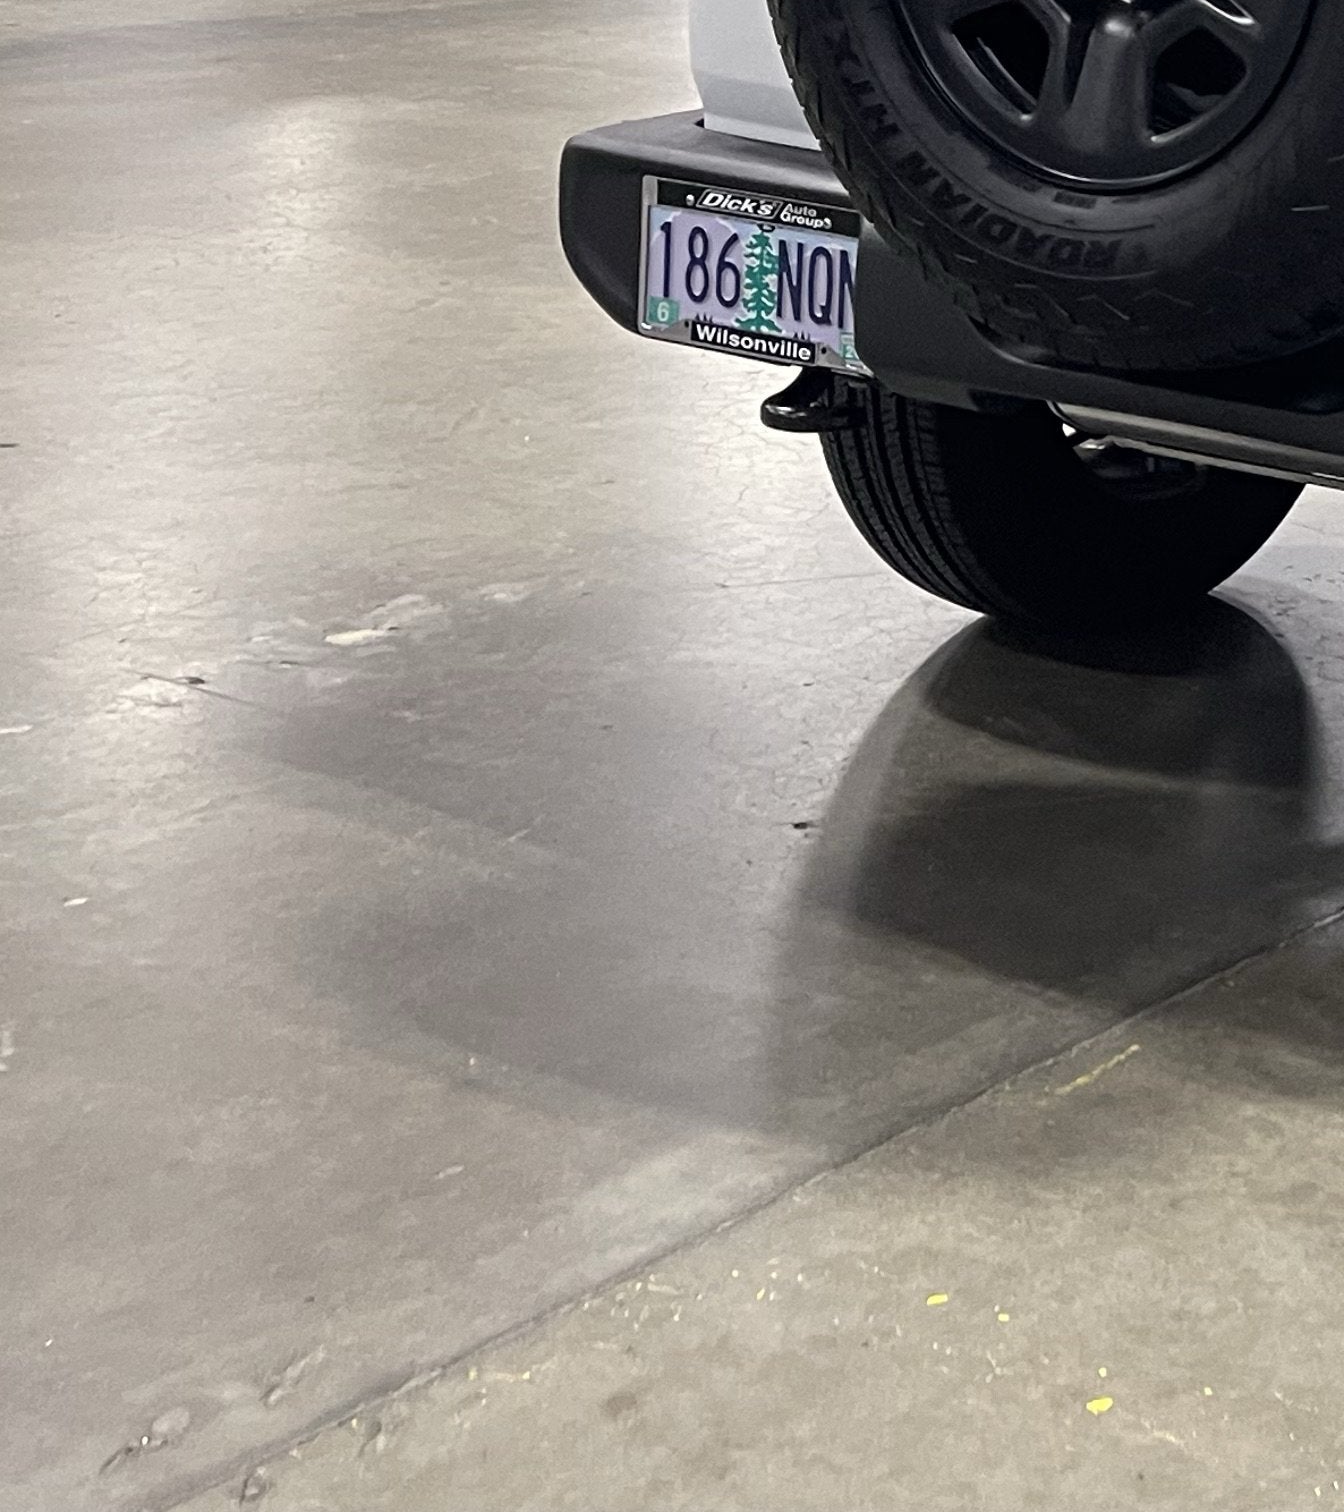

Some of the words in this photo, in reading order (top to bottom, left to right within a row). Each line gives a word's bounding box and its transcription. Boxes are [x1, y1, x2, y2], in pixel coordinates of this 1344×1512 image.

[701, 191, 775, 217] Dick's
[784, 203, 817, 217] Auto
[780, 210, 826, 229] Group
[660, 221, 741, 309] 186
[656, 301, 670, 322] 6
[696, 323, 812, 361] Wilsonville
